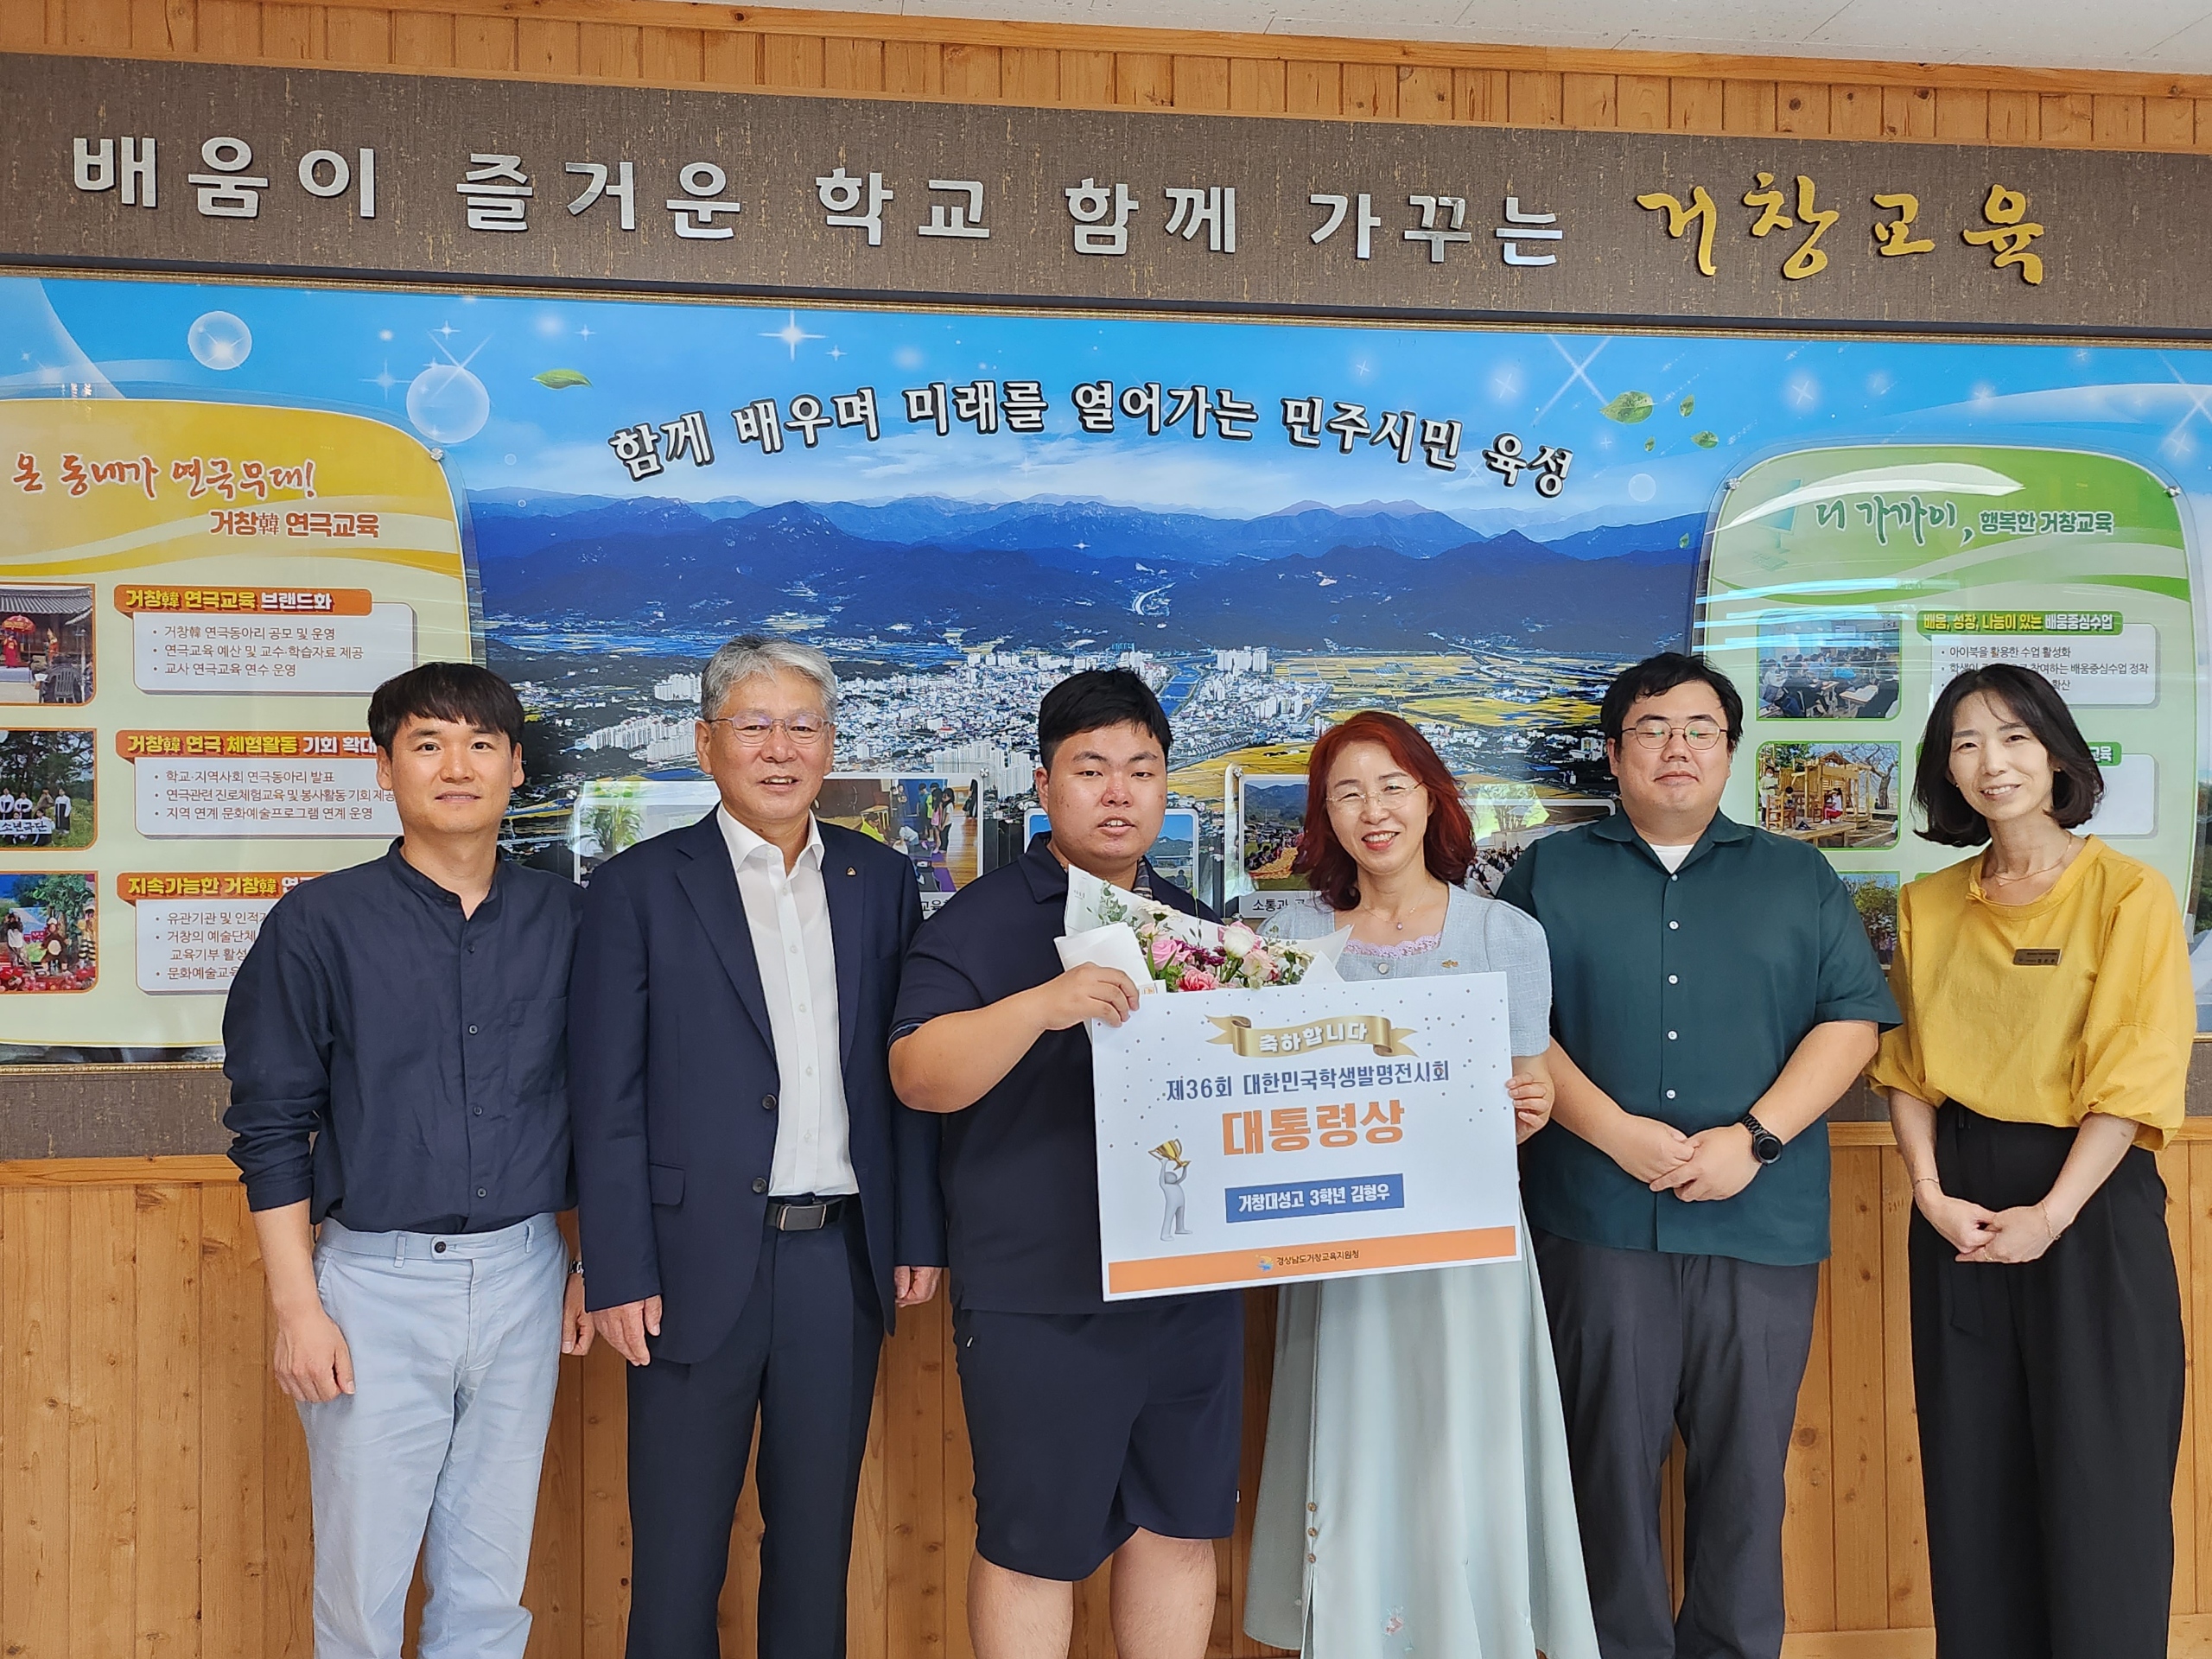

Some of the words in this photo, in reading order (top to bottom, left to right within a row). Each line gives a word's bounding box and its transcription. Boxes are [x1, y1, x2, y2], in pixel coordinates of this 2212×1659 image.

[73, 137, 375, 219] 배움이
[456, 153, 741, 239] 즐거운
[815, 167, 991, 246] 학교
[1065, 177, 1236, 257] 함께
[1310, 193, 1563, 267] 가꾸는
[1637, 173, 2044, 286] 거창교육
[609, 410, 715, 481] 함께
[731, 387, 880, 454] 배우며
[902, 380, 1048, 435] 미래를
[1072, 380, 1259, 441] 열어가는
[1281, 397, 1464, 471] 민주시민
[1484, 433, 1573, 499] 육성
[13, 454, 43, 493] 온
[60, 454, 160, 499] 동네가
[171, 458, 315, 499] 연극무대!
[210, 510, 280, 536] 거창韓
[285, 512, 379, 538] 연극교육
[1815, 499, 1847, 531] 더
[1855, 495, 1974, 546] 가까이,
[1980, 512, 2035, 533] 행복한
[2040, 512, 2113, 534] 거창교육
[126, 589, 179, 608] 거창韓
[183, 590, 257, 609] 연극교육
[261, 592, 334, 612] 브랜드화
[1923, 613, 1950, 631] 배움,
[1953, 613, 1980, 631] 성장,
[1982, 613, 2017, 630] 나눔이
[2019, 613, 2042, 630] 있는
[2044, 613, 2113, 631] 배움중심수업
[164, 626, 200, 639] 거창韓
[205, 626, 265, 639] 연극동아리
[269, 627, 293, 639] 공모
[297, 628, 308, 640] 및
[311, 628, 335, 640] 운영
[164, 644, 214, 657] 연극교육
[218, 645, 240, 658] 예산
[245, 645, 257, 658] 및
[340, 646, 364, 659] 제공
[1949, 646, 1988, 658] 아이북을
[1990, 647, 2018, 658] 활용한
[2021, 647, 2040, 658] 수업
[2042, 646, 2071, 658] 활성화
[164, 663, 188, 675] 교사
[194, 663, 242, 676] 연극교육
[245, 664, 270, 676] 연수
[272, 664, 296, 677] 운영
[2070, 663, 2127, 675] 배움중심수업
[2129, 663, 2149, 675] 정착
[2051, 679, 2071, 690] 확산
[127, 734, 181, 753] 거창韓
[186, 735, 222, 753] 연극
[226, 735, 298, 753] 체험활동
[302, 736, 338, 753] 기회
[247, 770, 307, 784] 연극동아리
[310, 771, 335, 784] 발표
[166, 788, 213, 802] 연극관련
[216, 788, 284, 802] 진로체험교육
[287, 789, 298, 802] 및
[301, 788, 346, 802] 봉사활동
[349, 789, 371, 802] 기회
[166, 806, 190, 820] 지역
[194, 807, 218, 820] 연계
[222, 807, 319, 820] 문화예술프로그램
[322, 807, 346, 820] 연계
[349, 807, 372, 820] 운영
[128, 876, 219, 895] 지속가능한
[224, 877, 276, 894] 거창韓
[167, 912, 216, 925] 유관기관
[219, 912, 232, 925] 및
[167, 930, 204, 943] 거창의
[207, 930, 256, 943] 예술단체
[169, 948, 219, 962] 교육기부
[1259, 1022, 1368, 1052] 축하합니다
[1166, 1076, 1233, 1102] 제36회
[1243, 1060, 1450, 1096] 대한민국학생발명전시회
[1222, 1099, 1406, 1156] 대통령상
[1238, 1190, 1305, 1212] 거창대성고
[1310, 1186, 1346, 1206] 3학년
[1351, 1183, 1390, 1204] 김형우
[1276, 1249, 1359, 1266] 경상남도거창교육지원청
